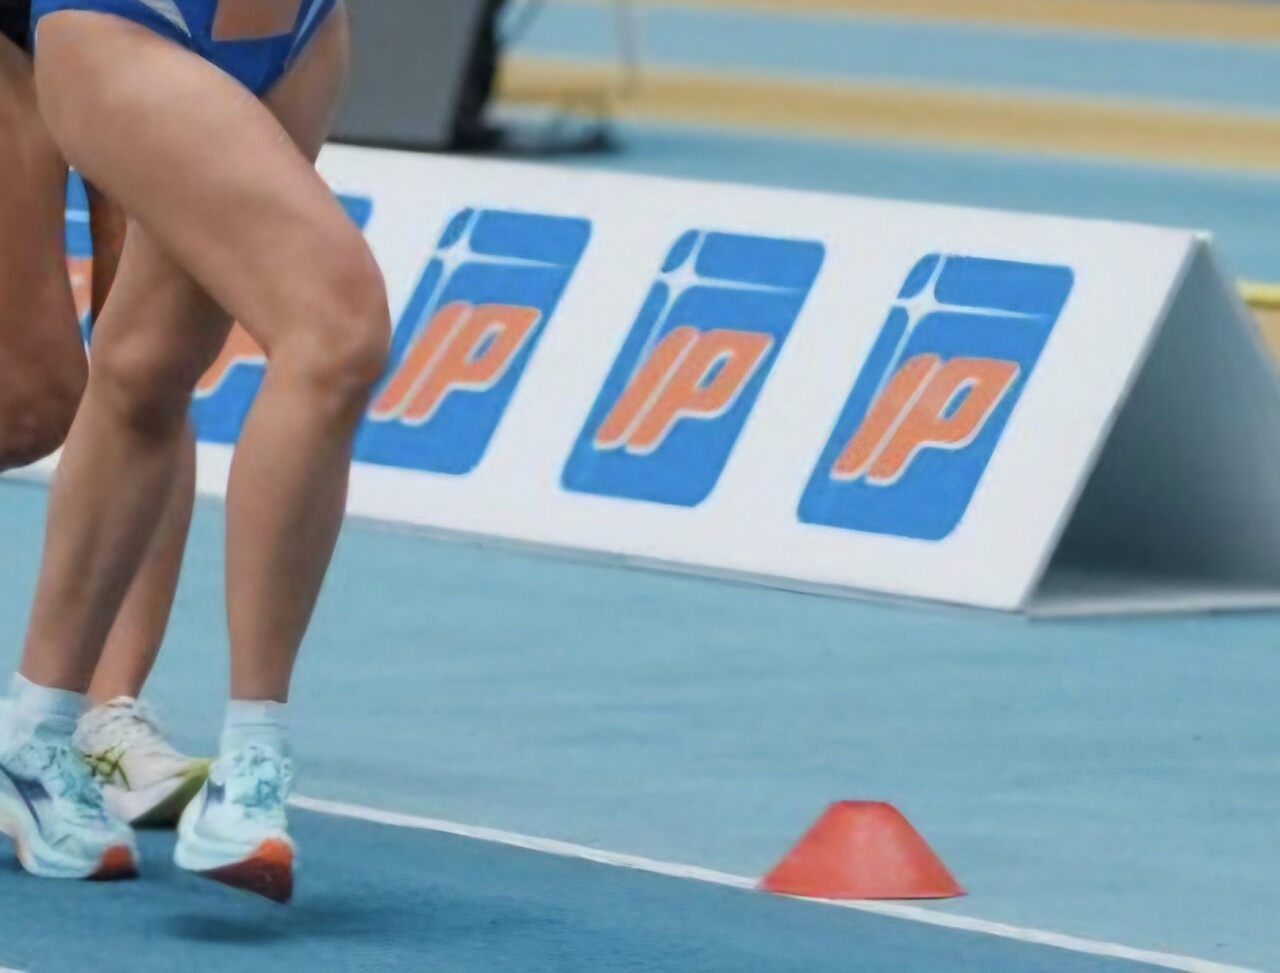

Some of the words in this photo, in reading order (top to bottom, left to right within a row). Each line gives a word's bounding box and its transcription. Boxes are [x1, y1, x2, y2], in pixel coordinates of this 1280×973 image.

[367, 300, 542, 425] IP
[592, 325, 776, 455] IP
[829, 352, 1020, 486] IP
